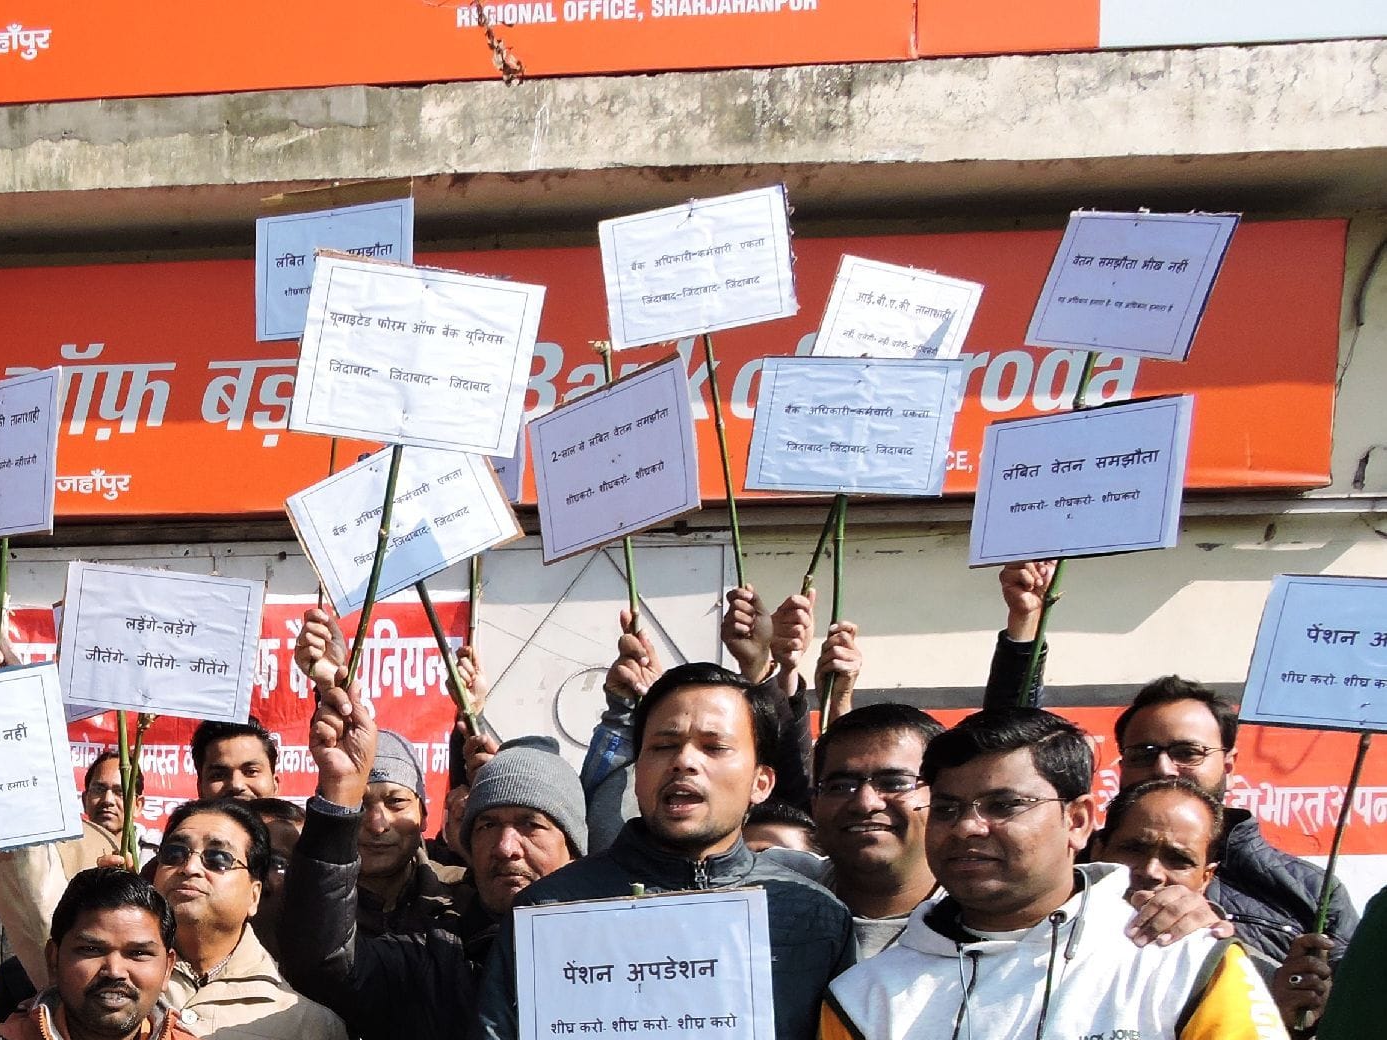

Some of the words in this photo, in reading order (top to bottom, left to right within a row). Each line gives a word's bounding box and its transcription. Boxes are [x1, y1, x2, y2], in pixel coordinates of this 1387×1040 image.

[564, 0, 644, 22] OFFICE,
[1073, 255, 1095, 267] वेतन
[1098, 256, 1138, 270] समझौता
[329, 311, 372, 328] यूनाइटेड
[378, 317, 407, 332] फोरम
[413, 320, 436, 336] ऑफ
[442, 323, 459, 338] बैंक
[449, 377, 492, 394] जिंदाबाद
[1003, 463, 1041, 481] लंबित
[1051, 458, 1086, 474] वेतन
[1095, 447, 1160, 470] समझौता
[1307, 623, 1360, 645] पेंशन
[189, 658, 230, 677] जीतेंगे
[3, 722, 28, 741] नहीं
[563, 960, 614, 985] पेंशन
[626, 956, 718, 983] अपडेशन
[551, 1019, 576, 1035] शीघ्र
[612, 1016, 639, 1032] शीघ्र
[678, 1014, 706, 1030] शीघ्र
[710, 1012, 737, 1029] करो
